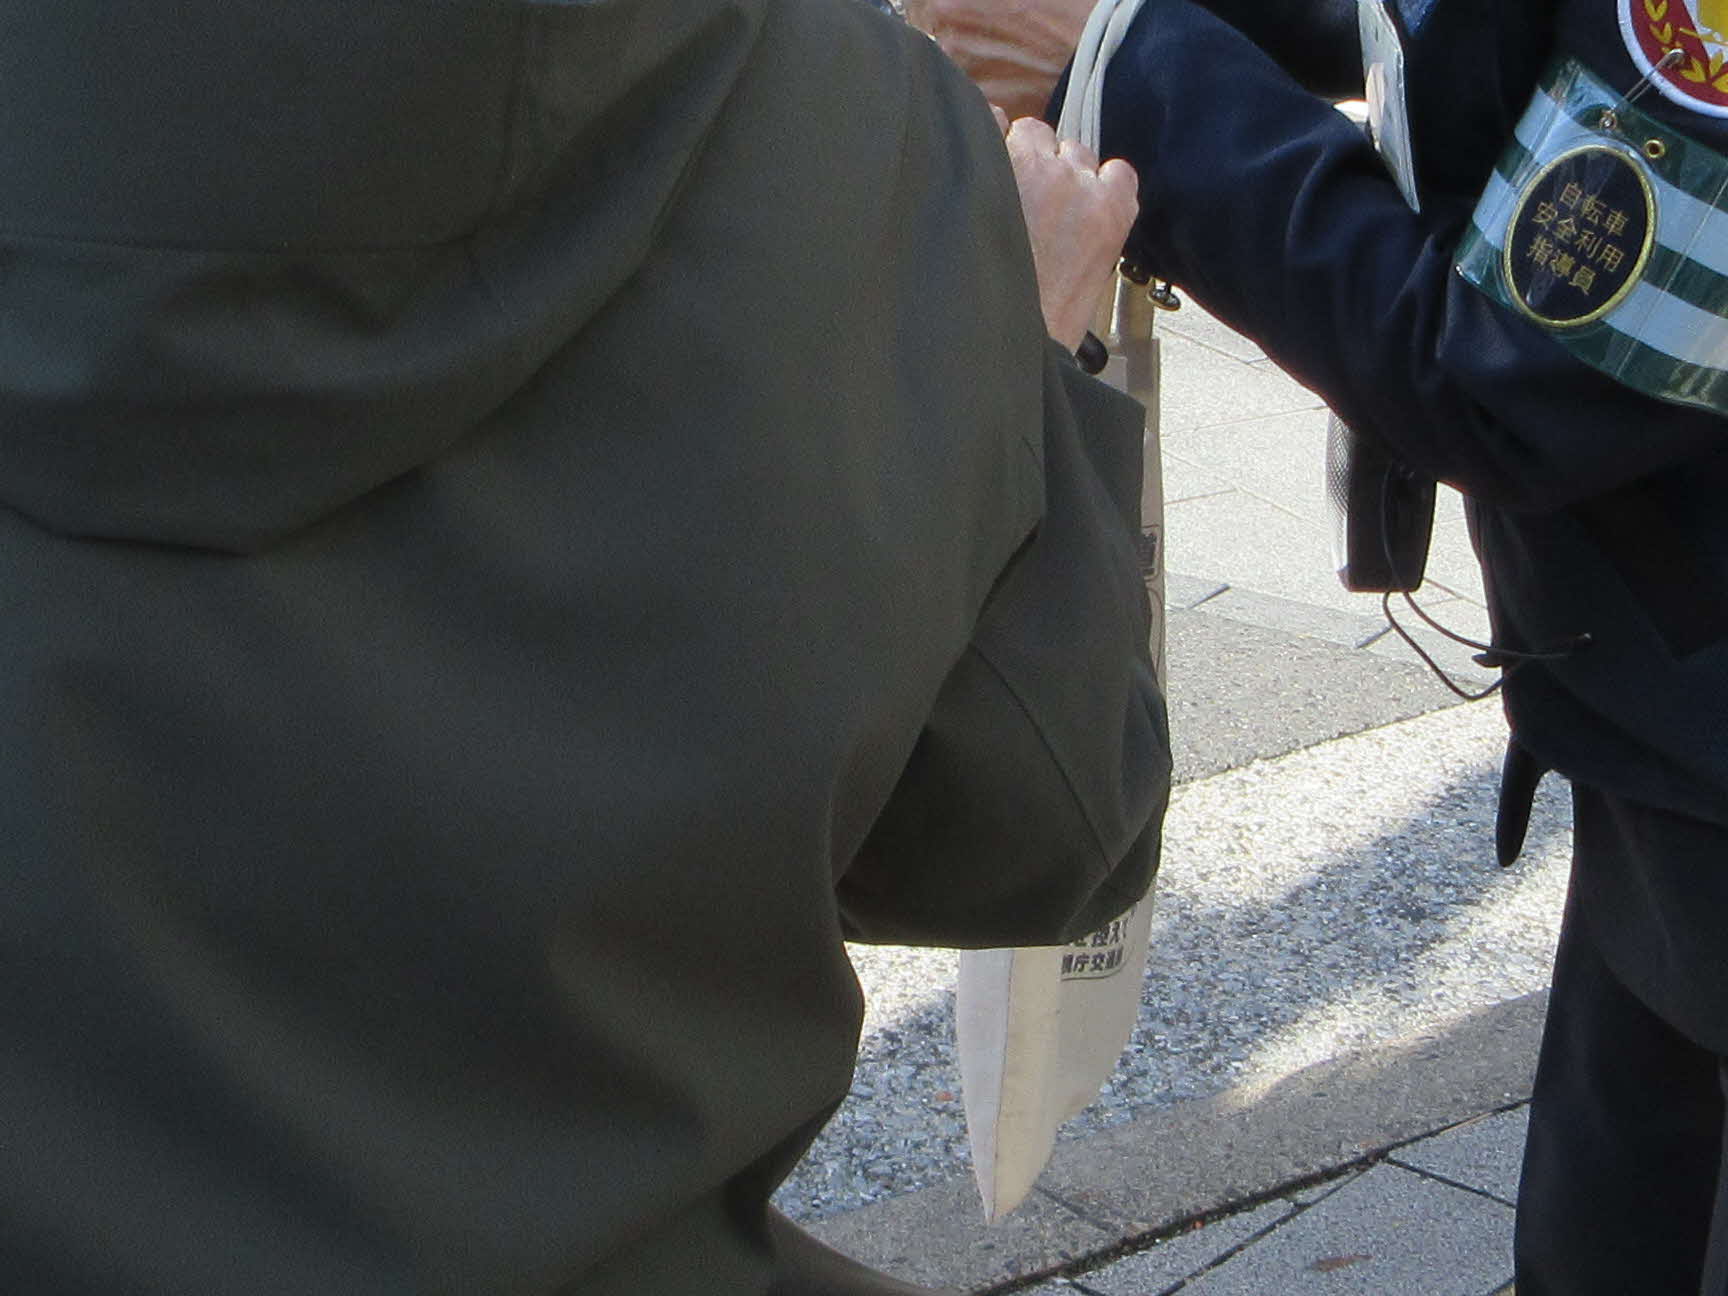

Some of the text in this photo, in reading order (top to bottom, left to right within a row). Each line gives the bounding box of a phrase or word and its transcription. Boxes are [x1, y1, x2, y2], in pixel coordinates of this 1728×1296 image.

[1531, 201, 1624, 273] 安全利用
[1559, 181, 1629, 237] 自転車
[1526, 235, 1597, 296] 指導員
